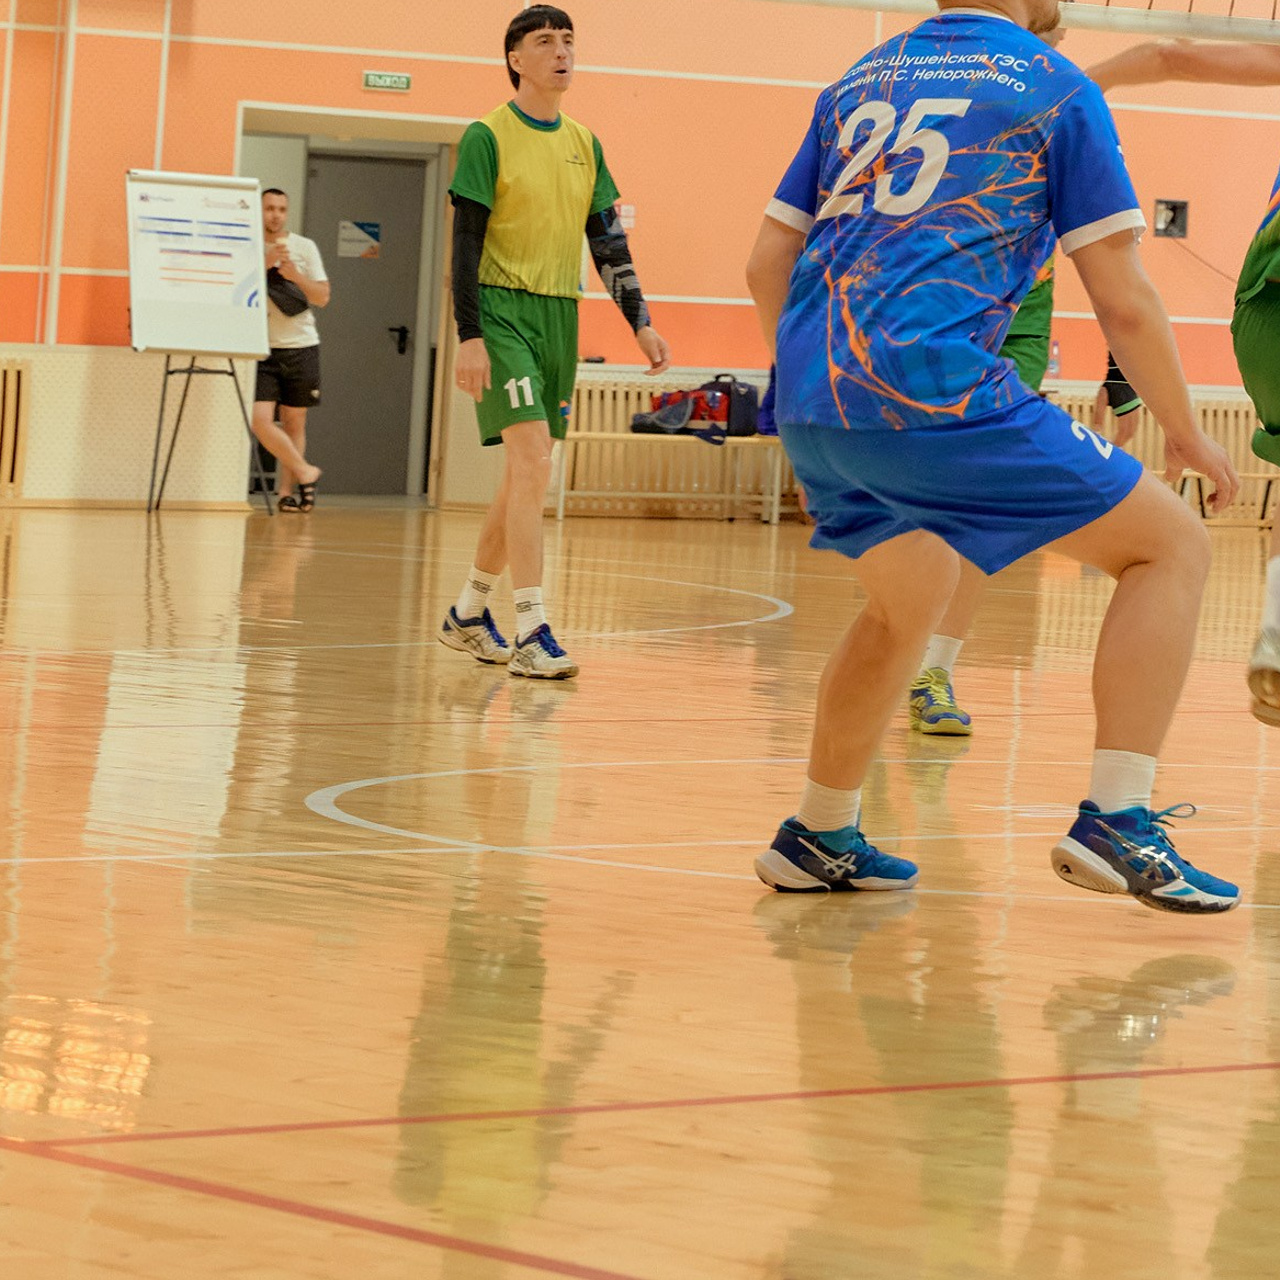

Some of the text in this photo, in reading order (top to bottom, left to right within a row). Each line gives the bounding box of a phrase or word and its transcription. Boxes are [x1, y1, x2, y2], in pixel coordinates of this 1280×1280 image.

[990, 53, 1029, 73] ГЭС
[912, 68, 1027, 93] Непорожнего
[815, 98, 973, 221] 25
[503, 376, 535, 409] 11
